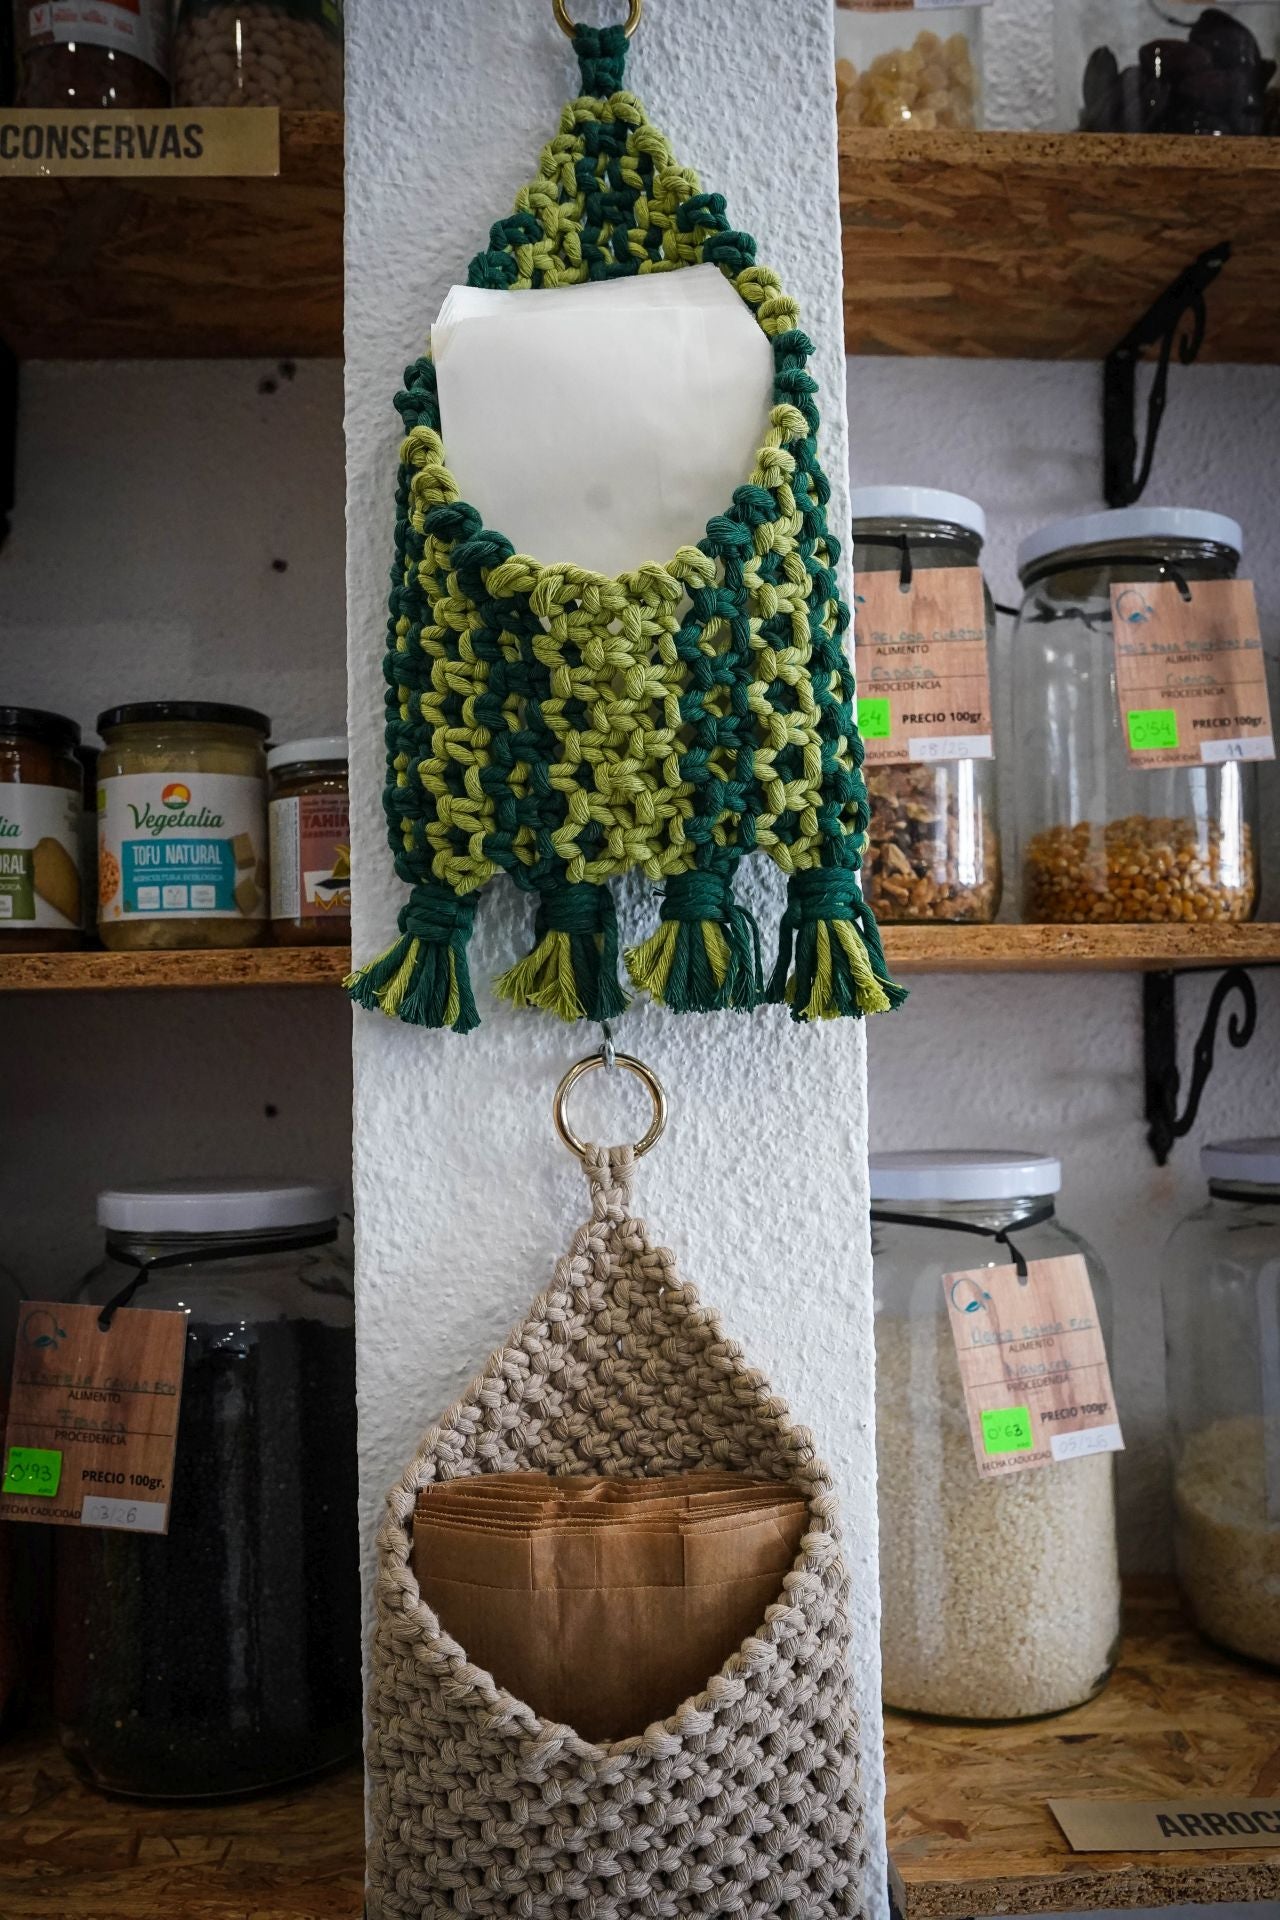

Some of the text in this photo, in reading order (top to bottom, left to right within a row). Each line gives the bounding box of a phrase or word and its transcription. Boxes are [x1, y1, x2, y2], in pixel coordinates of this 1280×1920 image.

[0, 124, 204, 160] CONSERVAS
[876, 645, 930, 656] ALIMENTO
[1165, 654, 1214, 664] ALIMENTO
[868, 680, 942, 693] PROCEDENCIA
[1161, 688, 1226, 699] PROCEDENCIA
[902, 712, 946, 724] PRECIO
[1192, 718, 1231, 729] PRECIO
[128, 803, 224, 835] Vegetalia
[132, 844, 222, 865] TOFU NATURAL
[1008, 1338, 1055, 1353] ALIMENTO
[1007, 1375, 1070, 1392] PROCEDENCIA
[68, 1390, 121, 1404] ALIMENTO
[1040, 1407, 1078, 1423] PRECIO
[54, 1430, 127, 1446] PROCEDENCIA
[81, 1470, 166, 1490] PRECIO 100gr.
[0, 1505, 81, 1520] FECHA CADUCIDAD
[1156, 1810, 1280, 1838] ARROC
